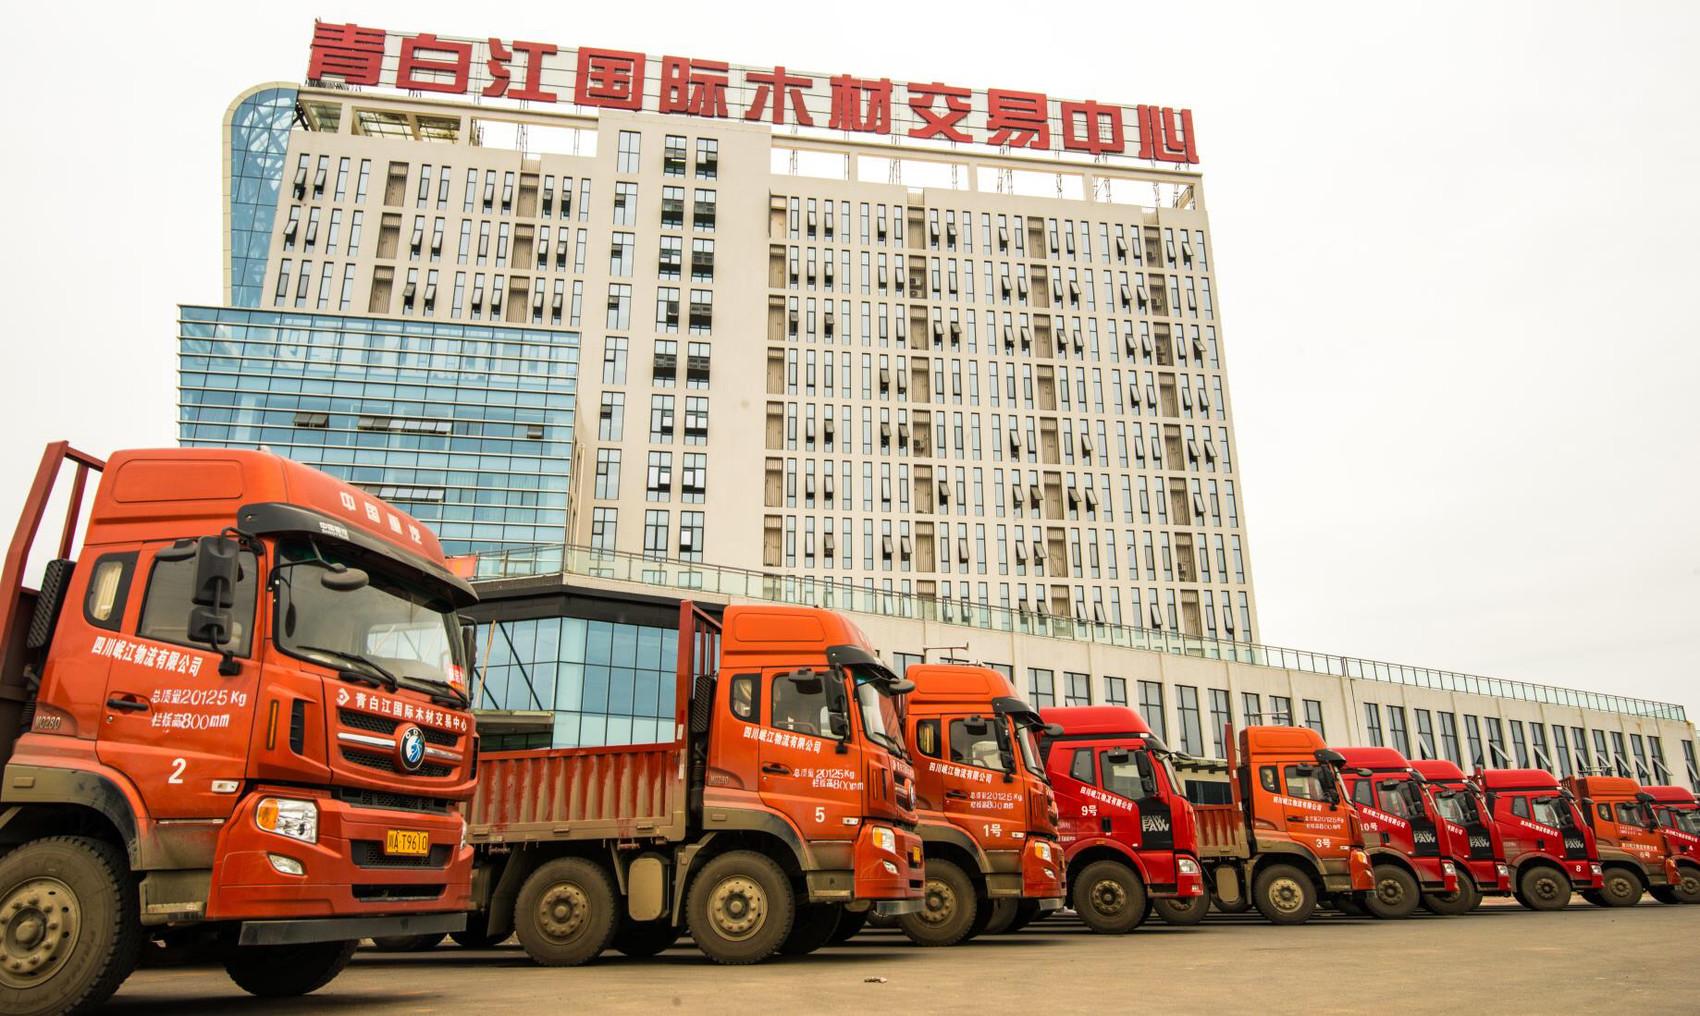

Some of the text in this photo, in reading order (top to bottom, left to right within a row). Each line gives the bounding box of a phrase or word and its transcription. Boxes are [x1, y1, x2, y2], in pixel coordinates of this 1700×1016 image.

[307, 22, 1199, 164] 青白江国际木材交易中心
[91, 635, 203, 677] 四川岷江物流有限公司
[355, 692, 467, 732] 青白江国际木材交易中心
[168, 758, 187, 784] 2
[815, 806, 825, 822] 5
[1081, 805, 1097, 816] 9号
[983, 823, 1002, 837] 1号
[1316, 838, 1331, 848] 3号
[1575, 865, 1582, 873] 8
